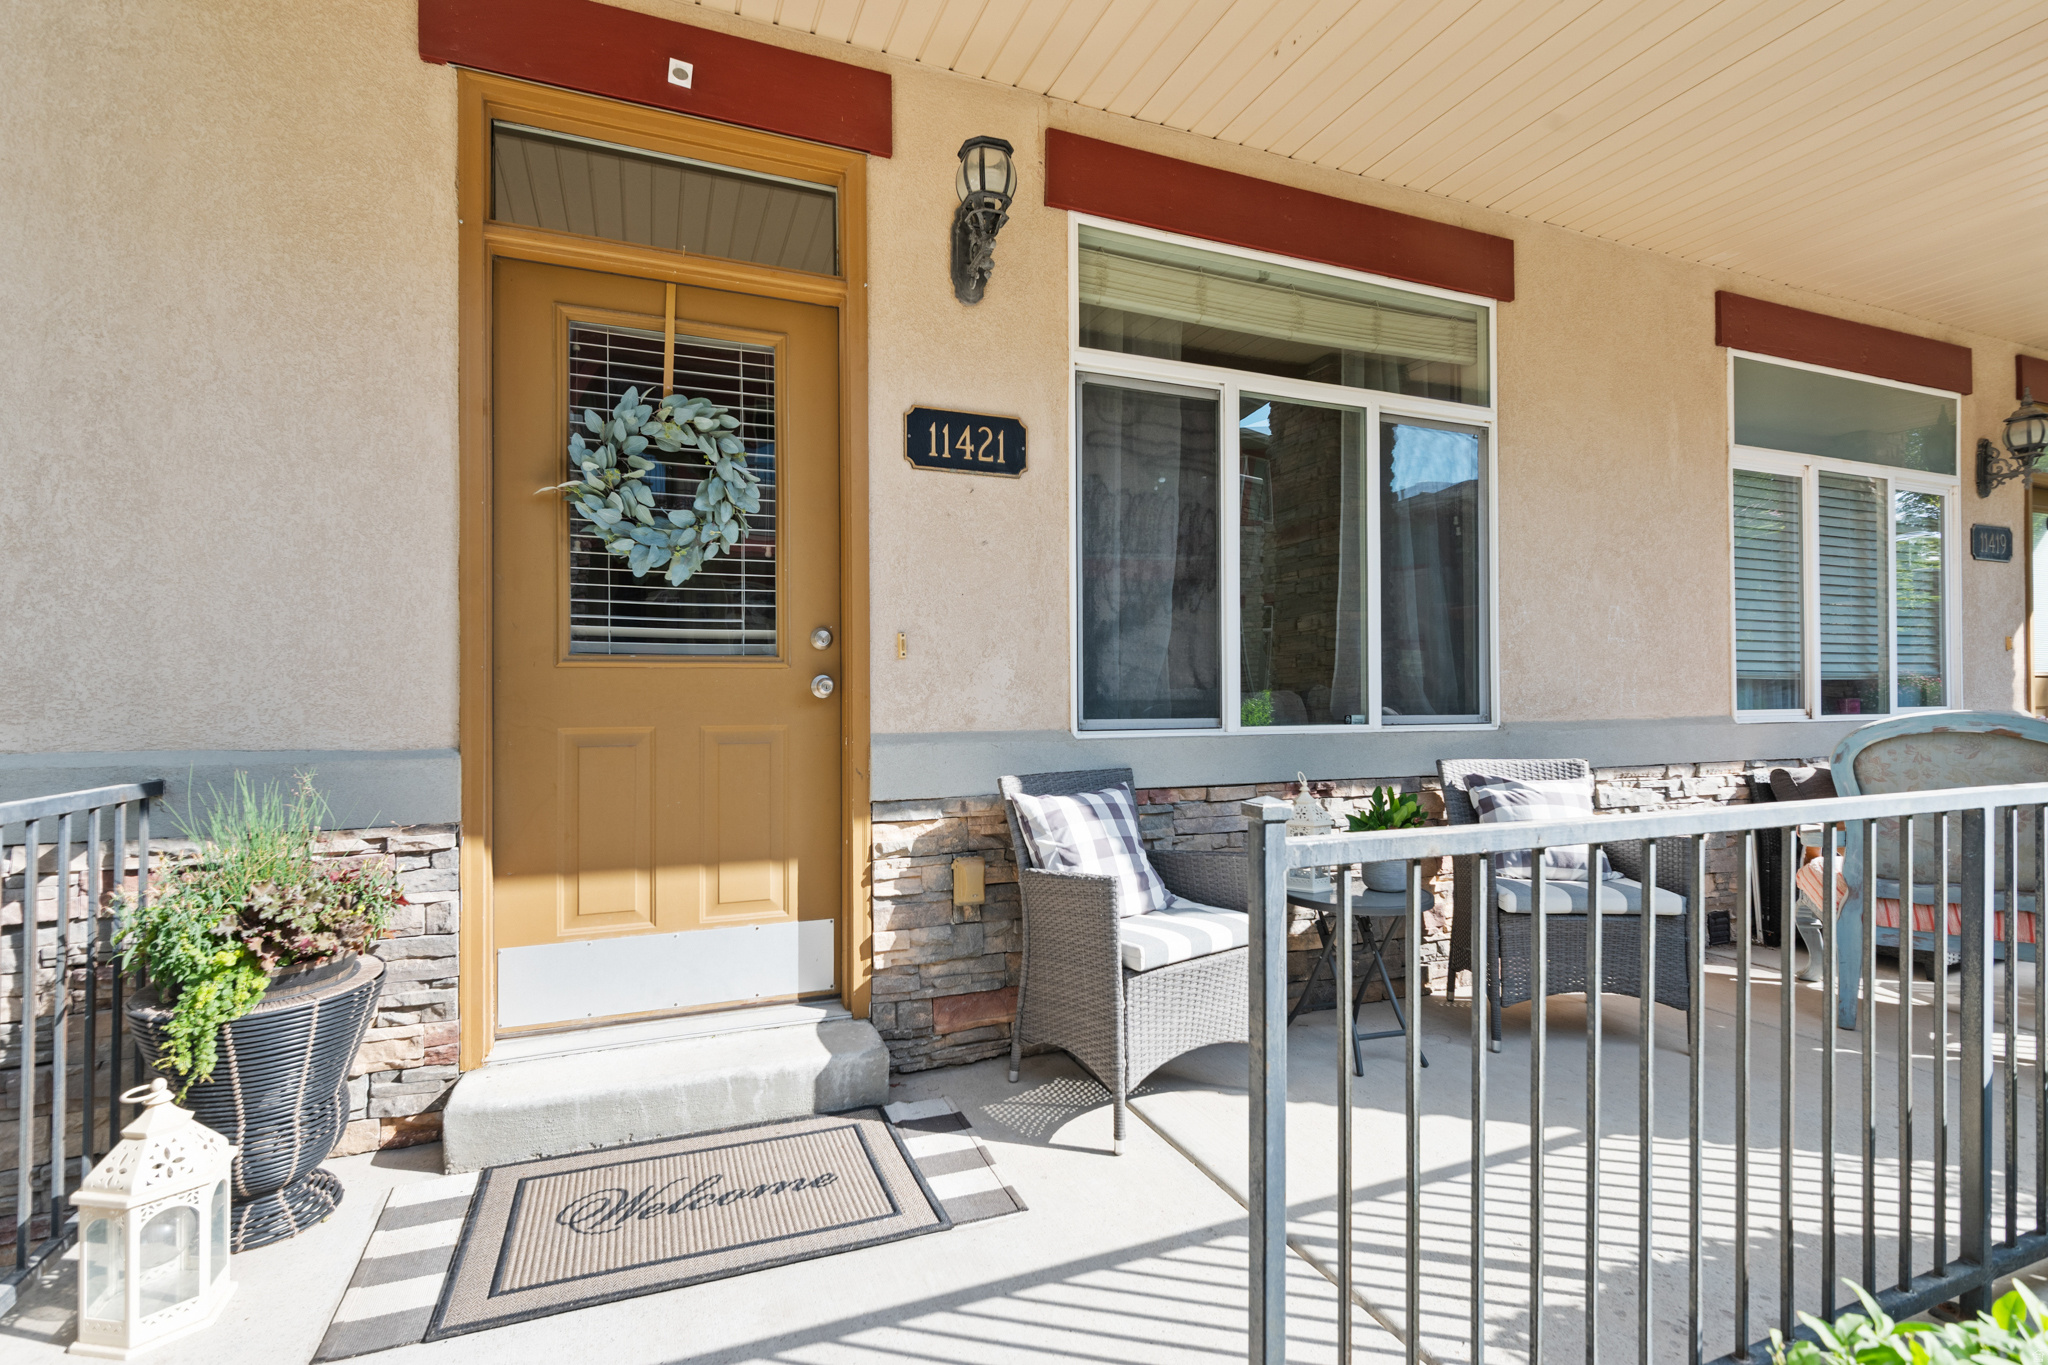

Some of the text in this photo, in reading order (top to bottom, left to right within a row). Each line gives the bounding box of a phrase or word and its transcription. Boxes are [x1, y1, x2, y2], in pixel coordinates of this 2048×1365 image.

[928, 421, 1006, 464] 11421
[1980, 532, 2007, 554] 11419
[556, 1172, 839, 1235] Welcome
